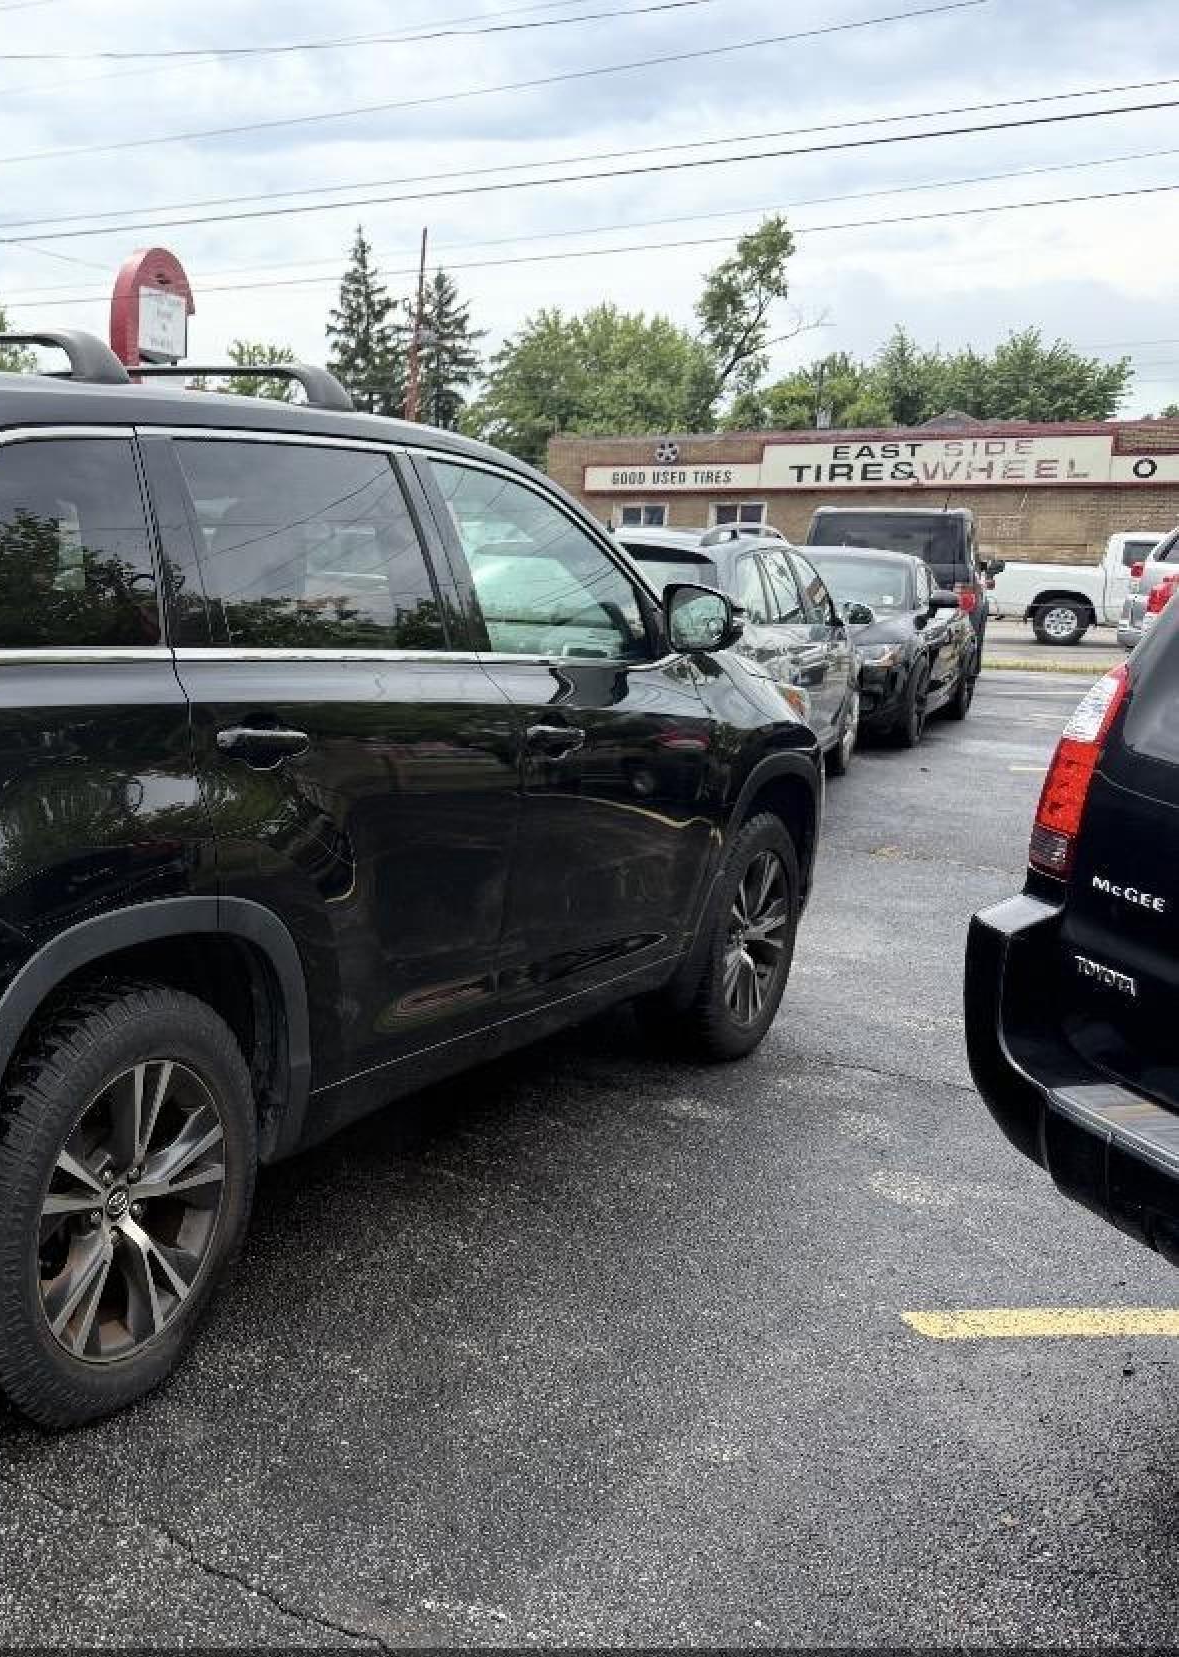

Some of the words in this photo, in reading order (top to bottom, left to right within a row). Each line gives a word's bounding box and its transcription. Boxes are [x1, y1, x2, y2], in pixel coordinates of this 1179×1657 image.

[833, 443, 923, 460] EAST
[944, 439, 1034, 457] SIDE
[612, 471, 646, 485] GOOD
[652, 471, 686, 485] USED
[693, 469, 732, 483] TIRES
[1092, 875, 1166, 912] McGEE
[1074, 955, 1137, 997] TOYOTA
